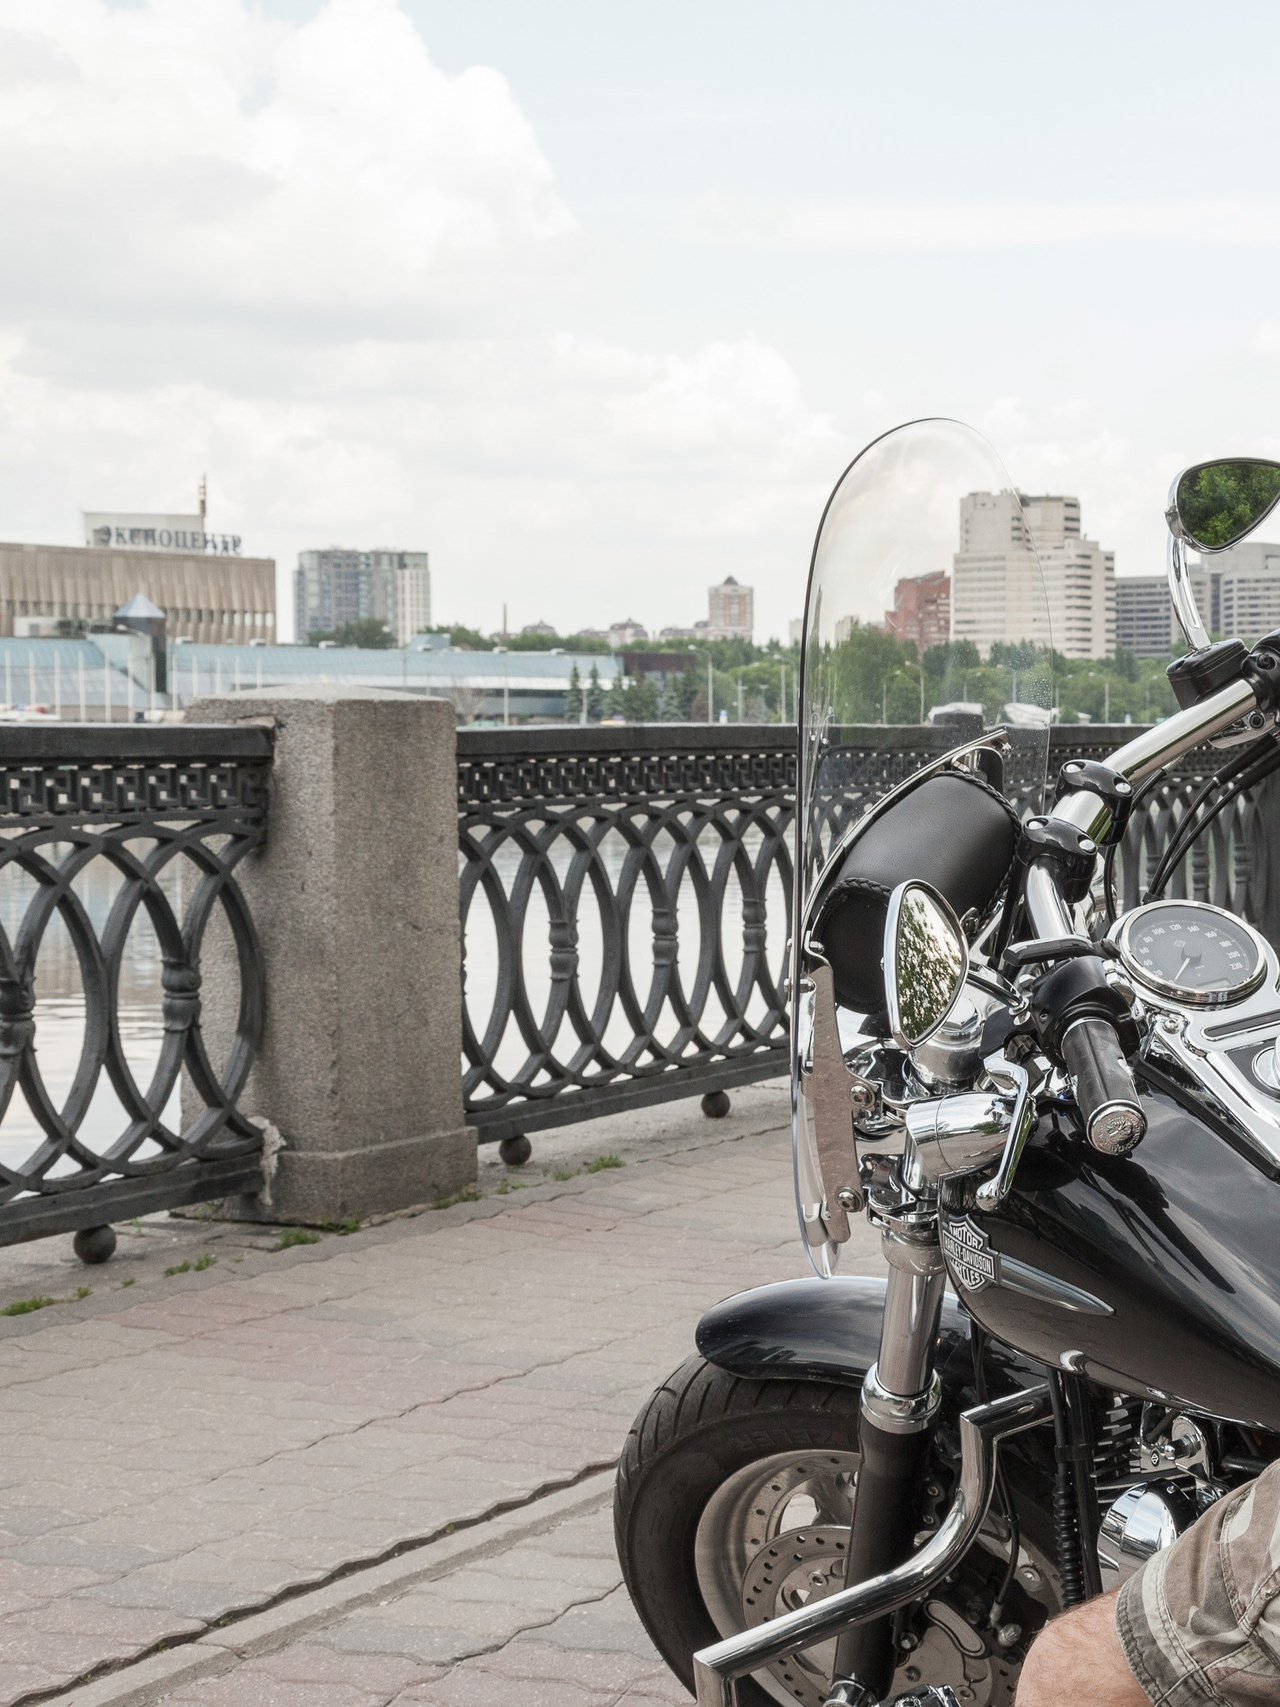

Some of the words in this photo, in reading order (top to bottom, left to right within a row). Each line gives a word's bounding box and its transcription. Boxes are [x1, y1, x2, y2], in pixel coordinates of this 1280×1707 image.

[97, 525, 242, 551] ЭКСПОЦЕНТР
[1152, 927, 1165, 935] 100
[1187, 925, 1200, 933] 140
[1205, 931, 1217, 939] 160
[1219, 940, 1232, 948] 180
[1227, 951, 1240, 959] 200
[1229, 962, 1243, 970] 220
[953, 1226, 978, 1249] MOTOR
[944, 1235, 991, 1274] HARLEY-DAVIDSON
